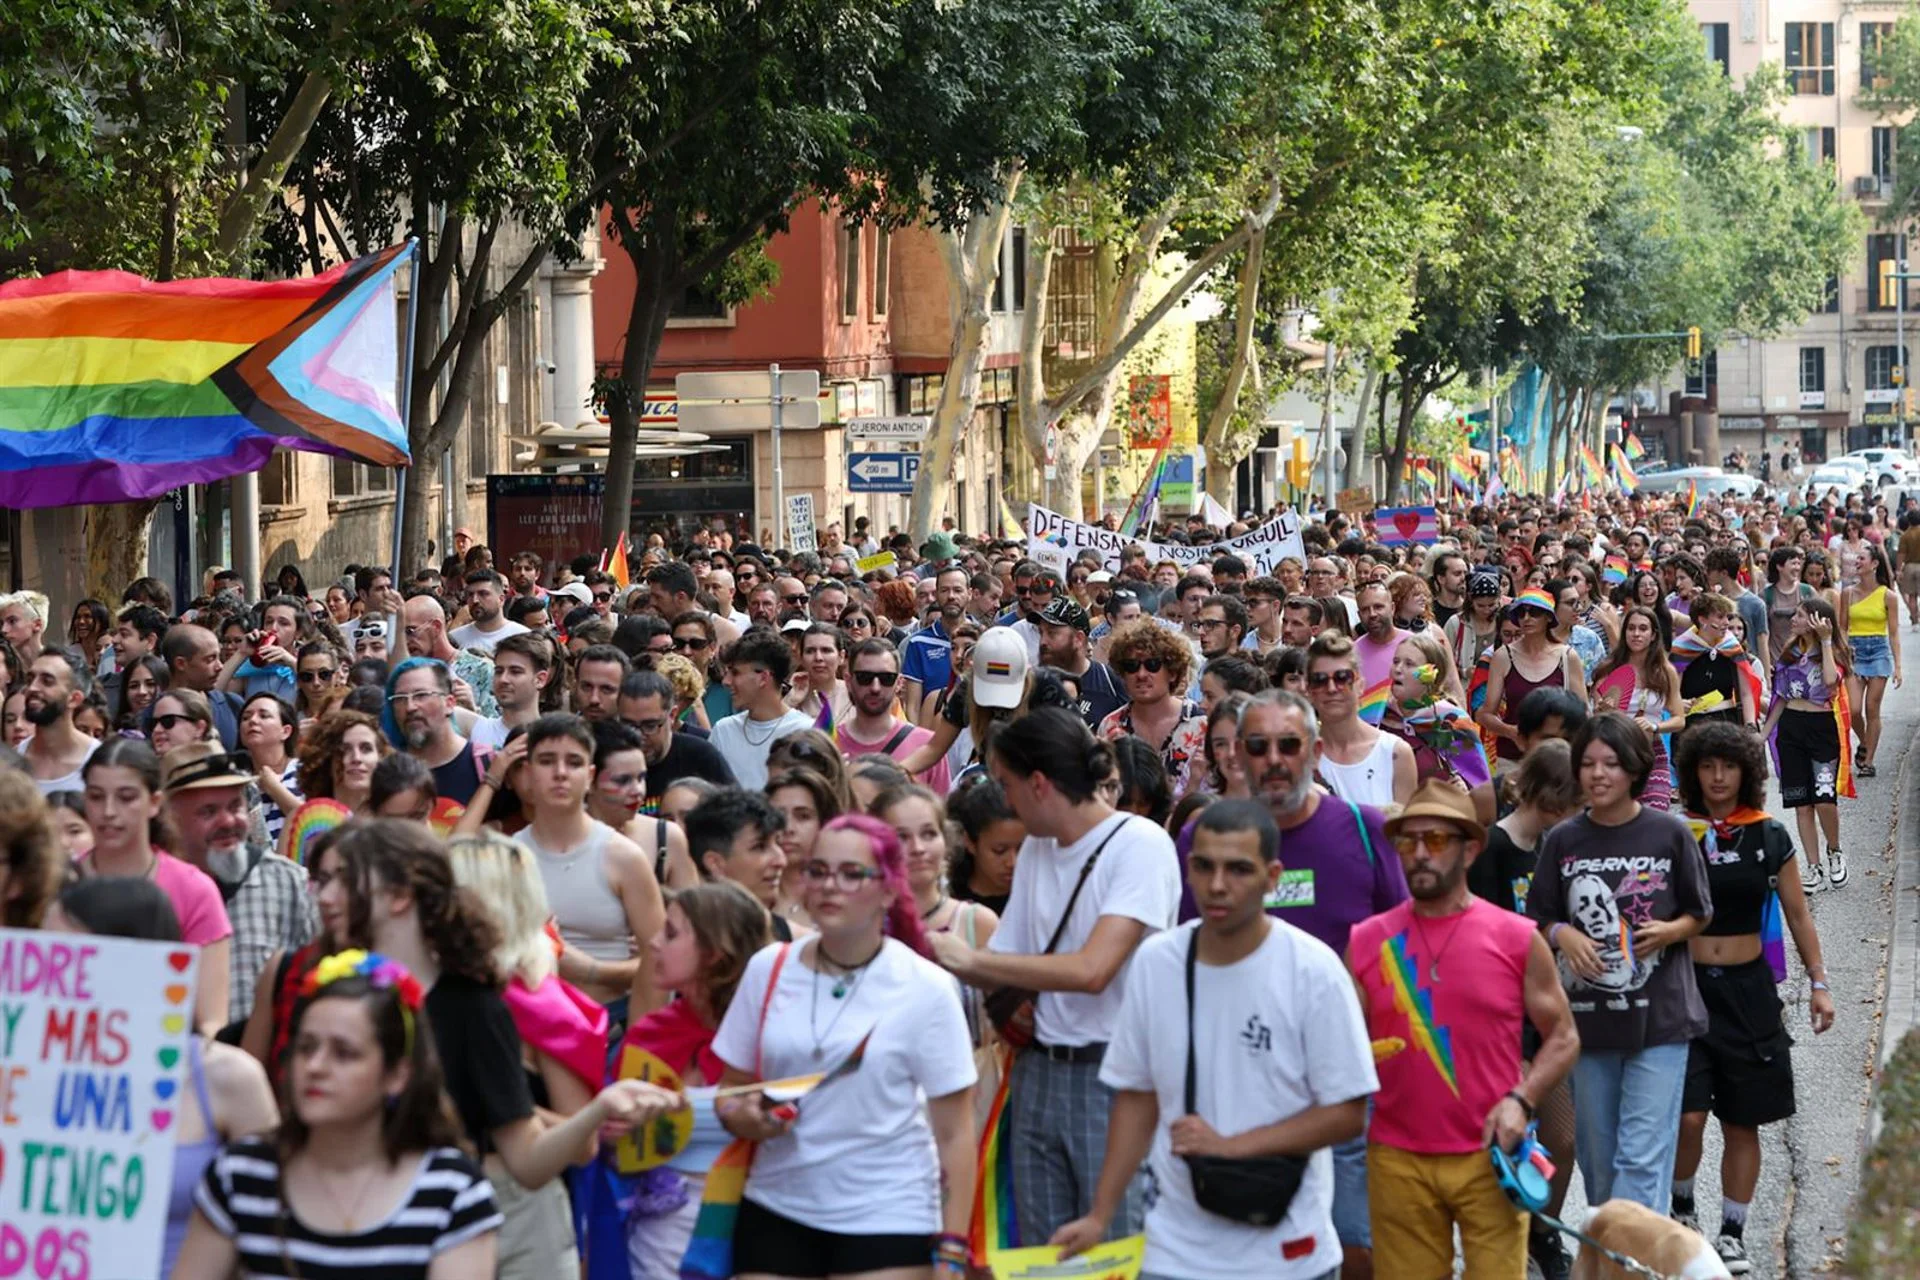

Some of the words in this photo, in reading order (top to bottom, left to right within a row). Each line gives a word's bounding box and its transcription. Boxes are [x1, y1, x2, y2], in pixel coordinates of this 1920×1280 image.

[860, 422, 892, 433] JERONI
[893, 422, 923, 433] ANTICH
[865, 464, 880, 474] 200
[906, 458, 919, 480] P
[40, 1007, 131, 1067] MAS
[55, 1071, 132, 1132] UNA
[22, 1142, 146, 1221] TENGO
